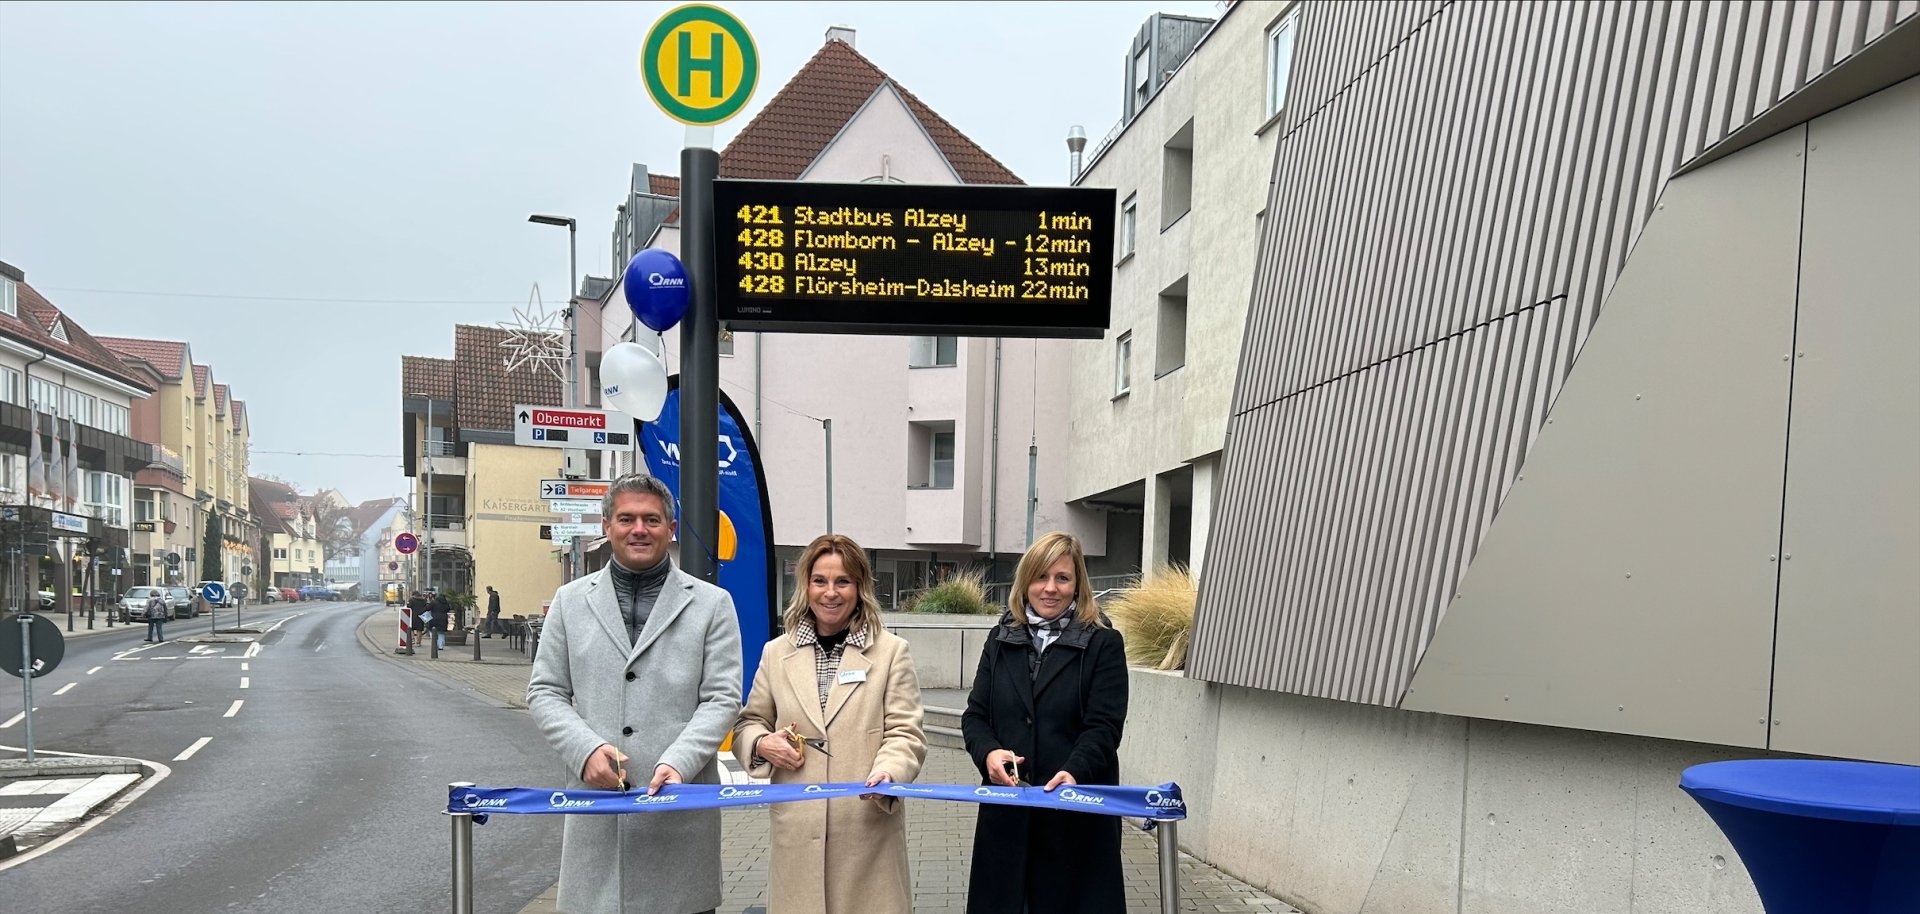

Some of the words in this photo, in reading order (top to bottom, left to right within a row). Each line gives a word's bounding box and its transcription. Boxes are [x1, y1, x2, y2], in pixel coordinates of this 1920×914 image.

[678, 31, 724, 98] H
[737, 205, 783, 224] 421
[795, 207, 893, 226] Stadtbus
[905, 209, 967, 232] Alzey
[738, 228, 783, 247] 428
[795, 230, 895, 249] Flomborn
[933, 233, 995, 256] Alzey
[739, 252, 784, 270] 430
[796, 253, 856, 276] Alzey
[740, 275, 784, 293] 428
[796, 276, 1014, 298] Flörsheim-Dalsheim
[536, 412, 601, 427] Obermarkt
[536, 430, 542, 439] P
[570, 486, 603, 494] Tiefgarage
